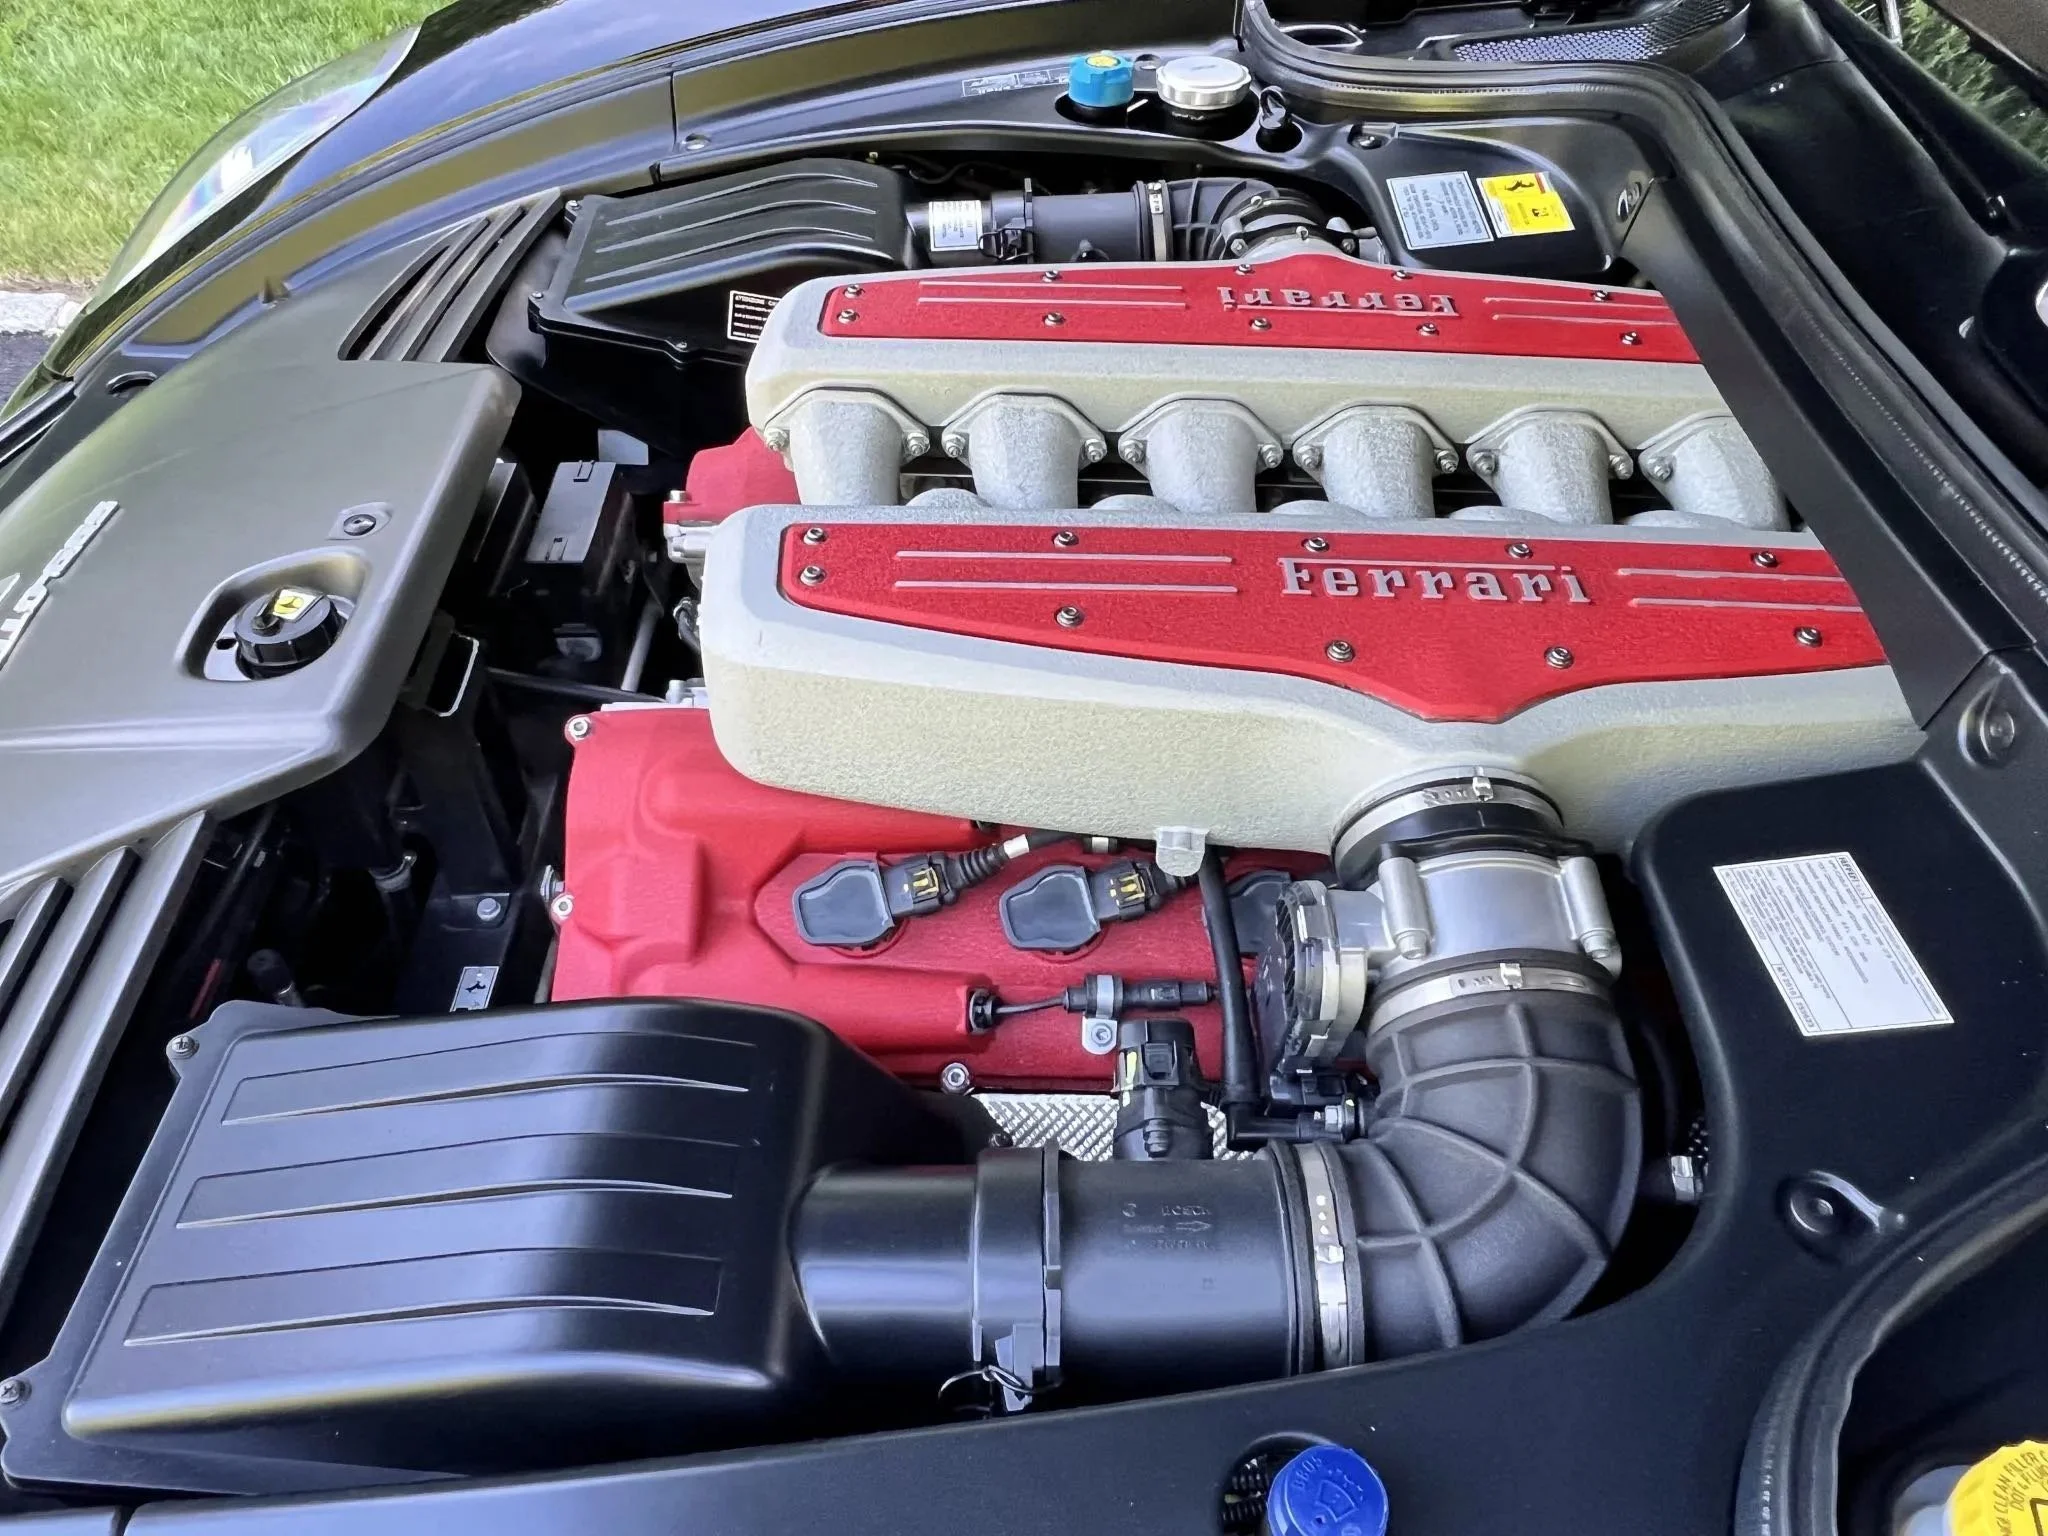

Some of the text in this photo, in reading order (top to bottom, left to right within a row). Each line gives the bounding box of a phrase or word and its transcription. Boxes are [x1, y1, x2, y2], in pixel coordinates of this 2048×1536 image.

[1217, 286, 1460, 317] Ferrari
[1277, 557, 1592, 604] Ferrari
[1993, 1474, 2012, 1514] CLEAN
[2010, 1487, 2026, 1511] DOT
